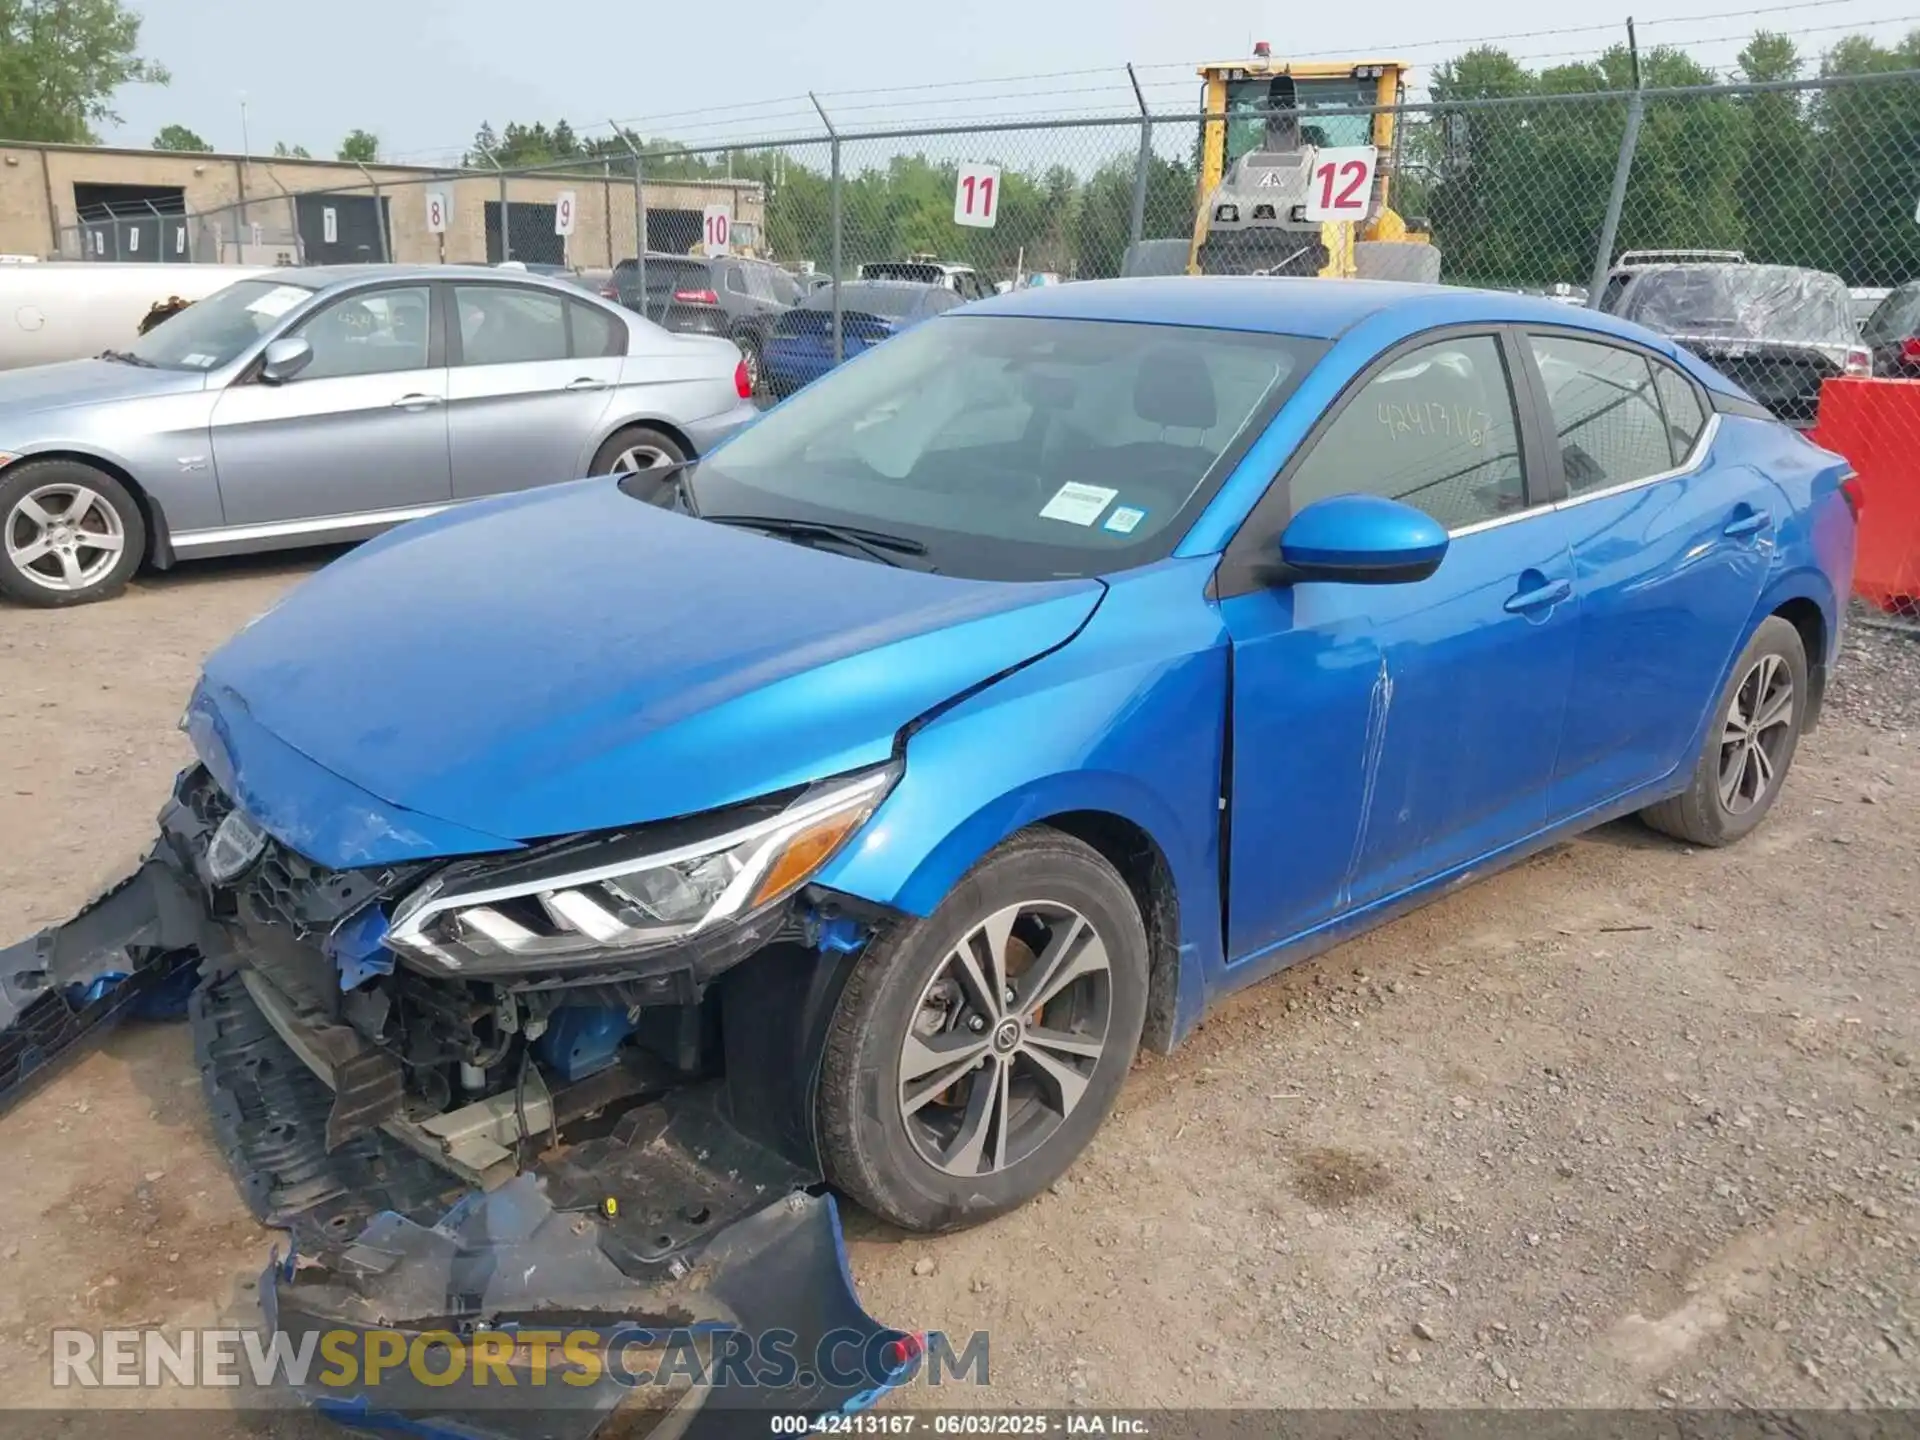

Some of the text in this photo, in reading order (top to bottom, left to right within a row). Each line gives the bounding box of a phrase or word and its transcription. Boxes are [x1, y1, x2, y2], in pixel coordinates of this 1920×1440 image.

[962, 175, 993, 217] 11
[1317, 160, 1368, 209] 12
[431, 201, 441, 226] 8
[560, 200, 570, 227] 9
[705, 215, 727, 245] 10
